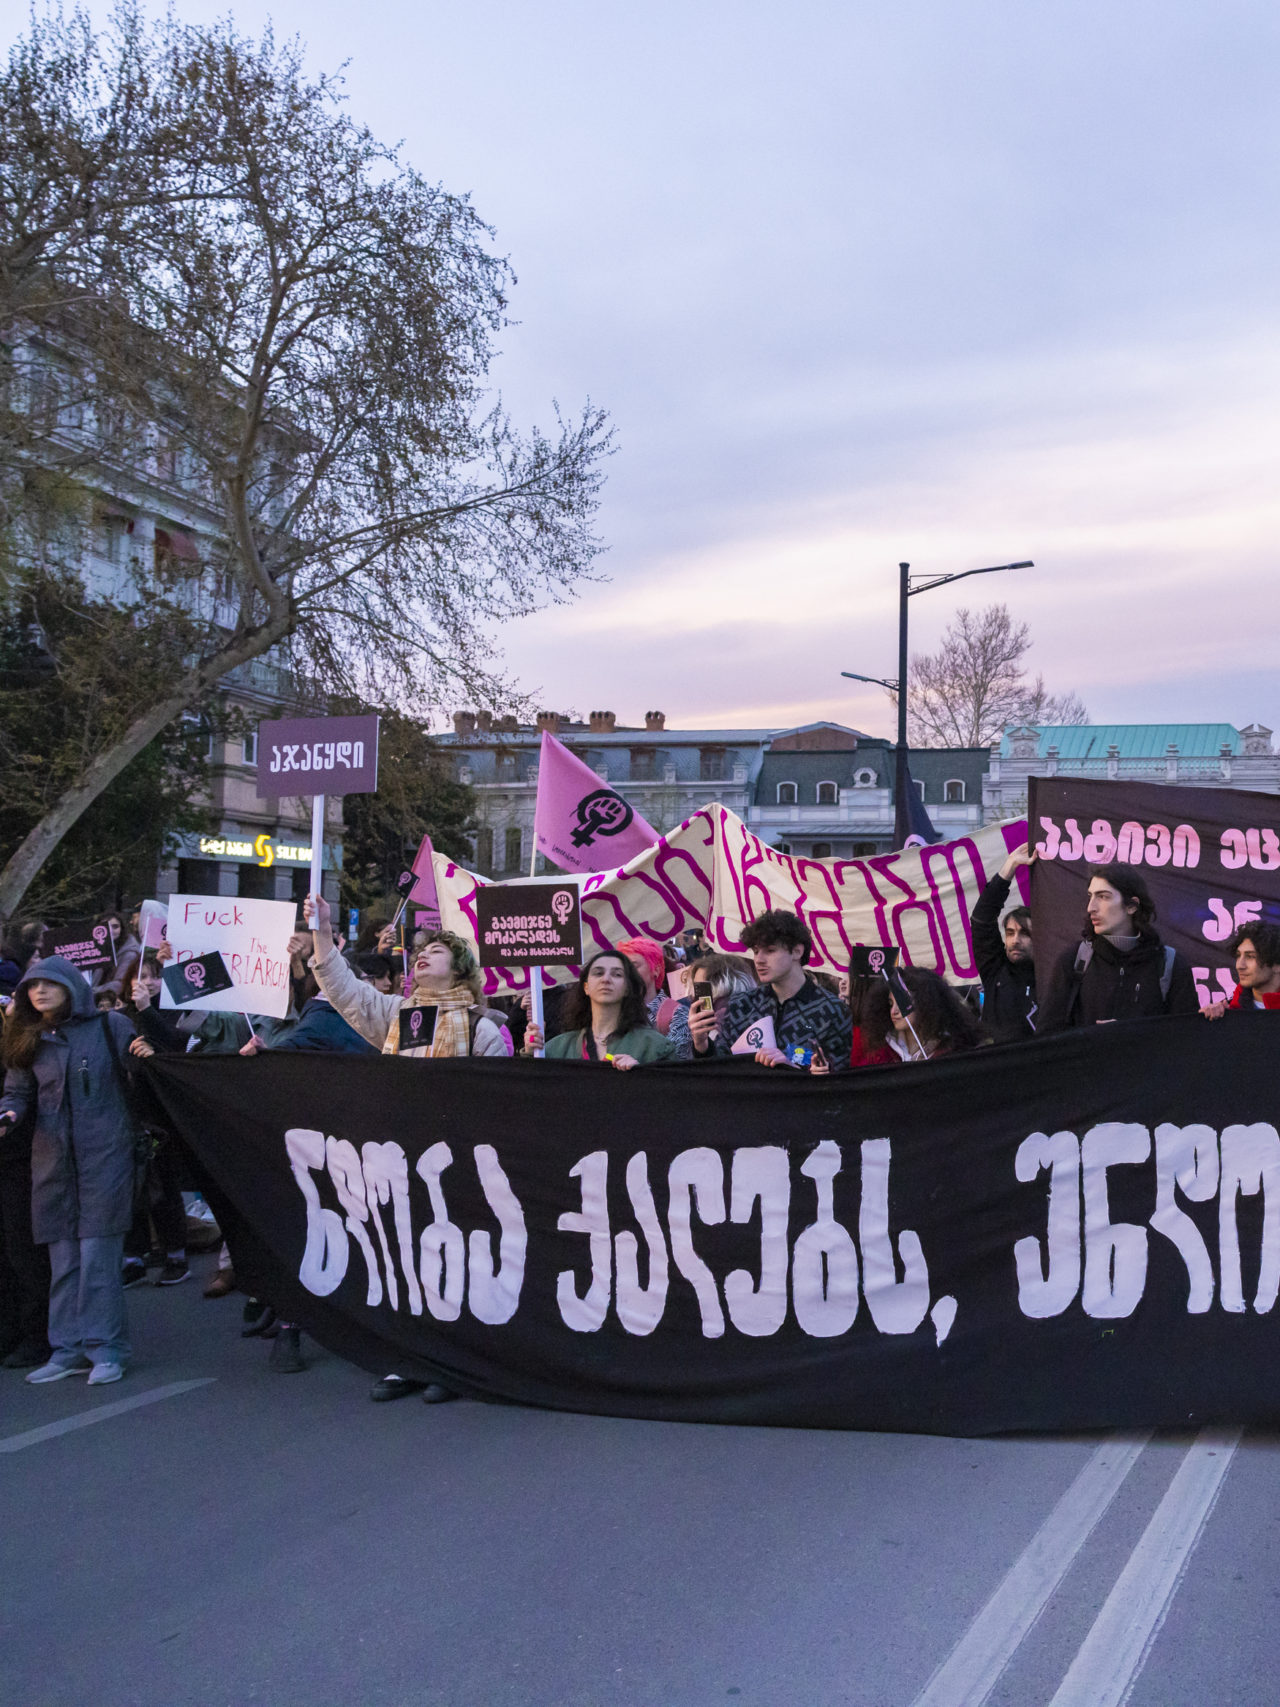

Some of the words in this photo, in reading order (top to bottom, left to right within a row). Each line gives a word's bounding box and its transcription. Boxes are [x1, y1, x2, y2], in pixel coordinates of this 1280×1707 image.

[270, 741, 364, 773] აჯანყდი
[1036, 816, 1201, 868] პატივი
[184, 902, 244, 926] Fuck
[491, 915, 553, 930] გაემიჯნე
[484, 929, 561, 945] მოძალადეს
[177, 949, 290, 990] RIARCHY
[285, 1128, 528, 1326] ნდობა
[556, 1136, 959, 1348] ქალებს,
